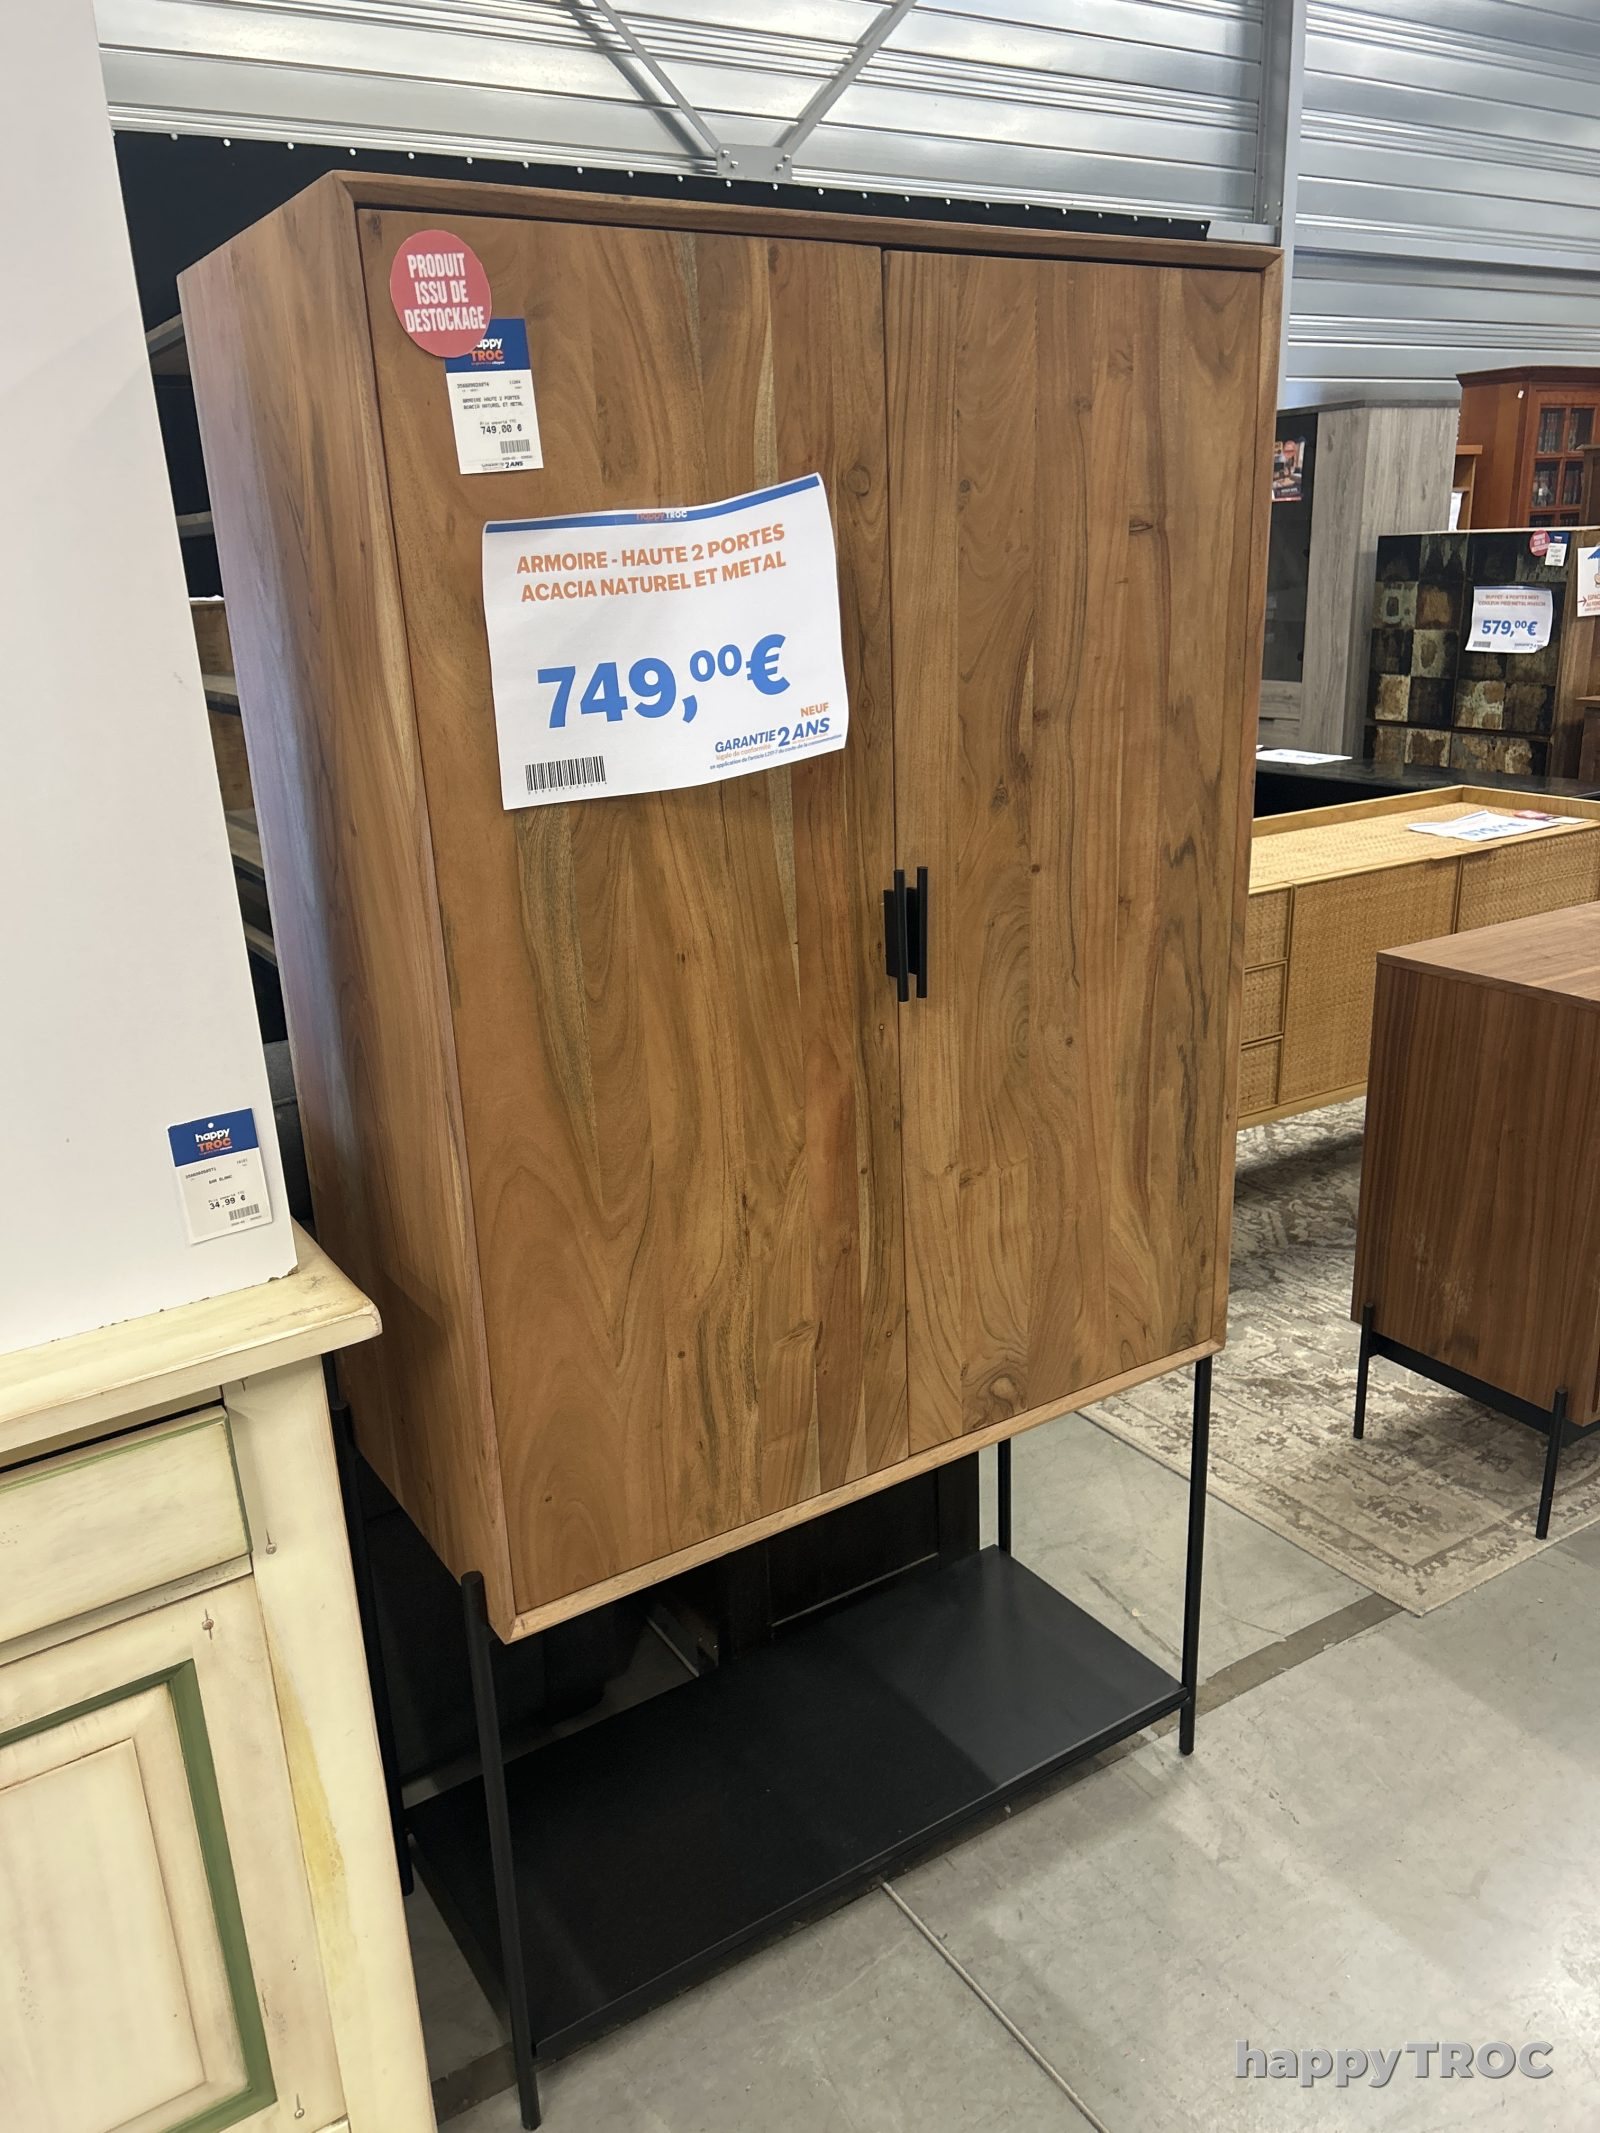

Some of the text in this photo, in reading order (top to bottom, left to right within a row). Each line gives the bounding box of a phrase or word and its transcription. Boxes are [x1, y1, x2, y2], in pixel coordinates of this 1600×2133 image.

[406, 252, 466, 279] PRODUIT
[414, 279, 469, 305] ISSU DE
[403, 305, 487, 333] DESTOCKAGE
[476, 338, 503, 349] appy
[471, 350, 504, 361] TROC
[480, 424, 512, 435] 749,00
[516, 551, 609, 574] ARMOIRE
[621, 545, 689, 567] HAUTE
[691, 544, 704, 561] 2
[707, 523, 786, 558] PORTES
[521, 551, 787, 602] ACACIA NATUREL ET METAL
[1481, 620, 1538, 638] 579,00€
[800, 702, 829, 717] NEUF
[715, 729, 776, 753] GARANTIE
[777, 726, 791, 747] 2
[791, 717, 830, 741] ANS
[195, 1128, 230, 1142] happy
[197, 1137, 232, 1152] TROC
